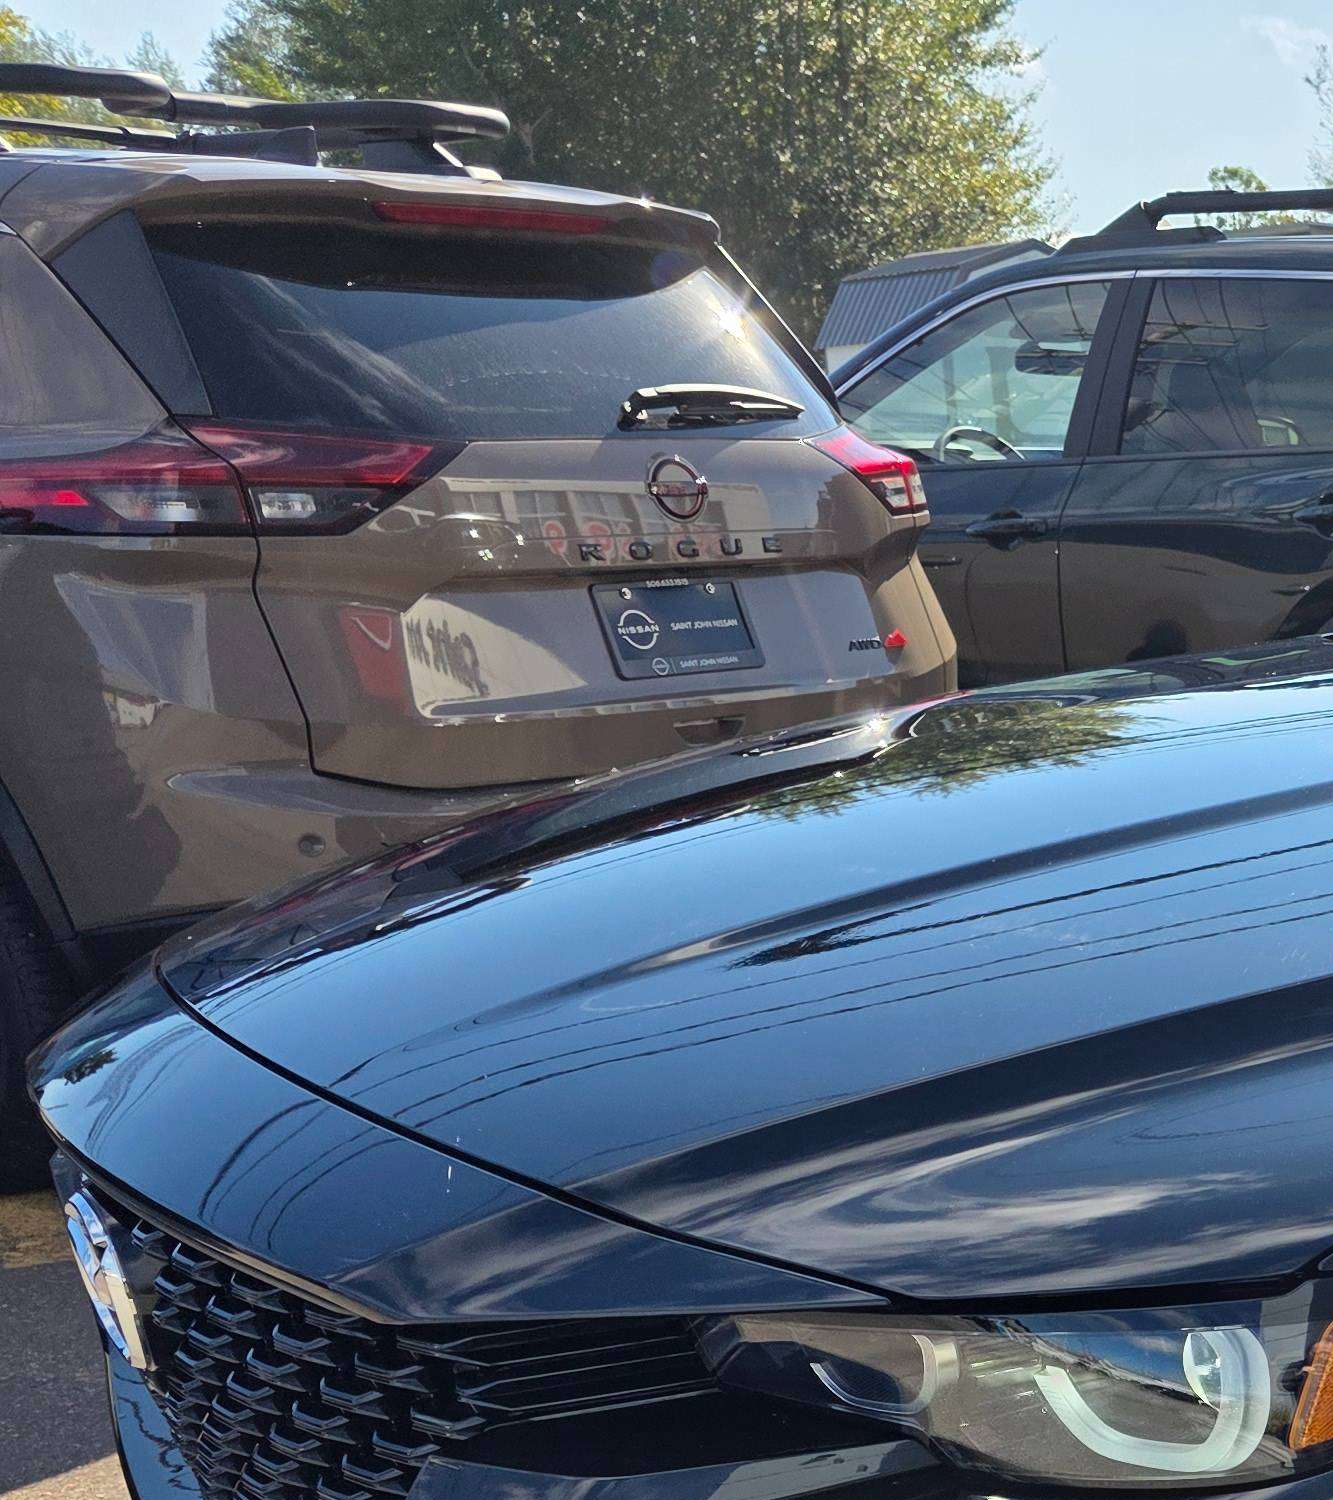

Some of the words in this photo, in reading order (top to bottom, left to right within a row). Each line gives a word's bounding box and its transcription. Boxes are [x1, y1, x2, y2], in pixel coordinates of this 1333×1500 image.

[577, 536, 783, 562] ROGUE
[618, 624, 660, 635] NISSAN
[670, 621, 692, 631] SAINT
[693, 620, 713, 630] JOHN
[713, 619, 738, 628] NISSAN
[848, 639, 882, 652] AWD
[699, 657, 716, 667] JOHN
